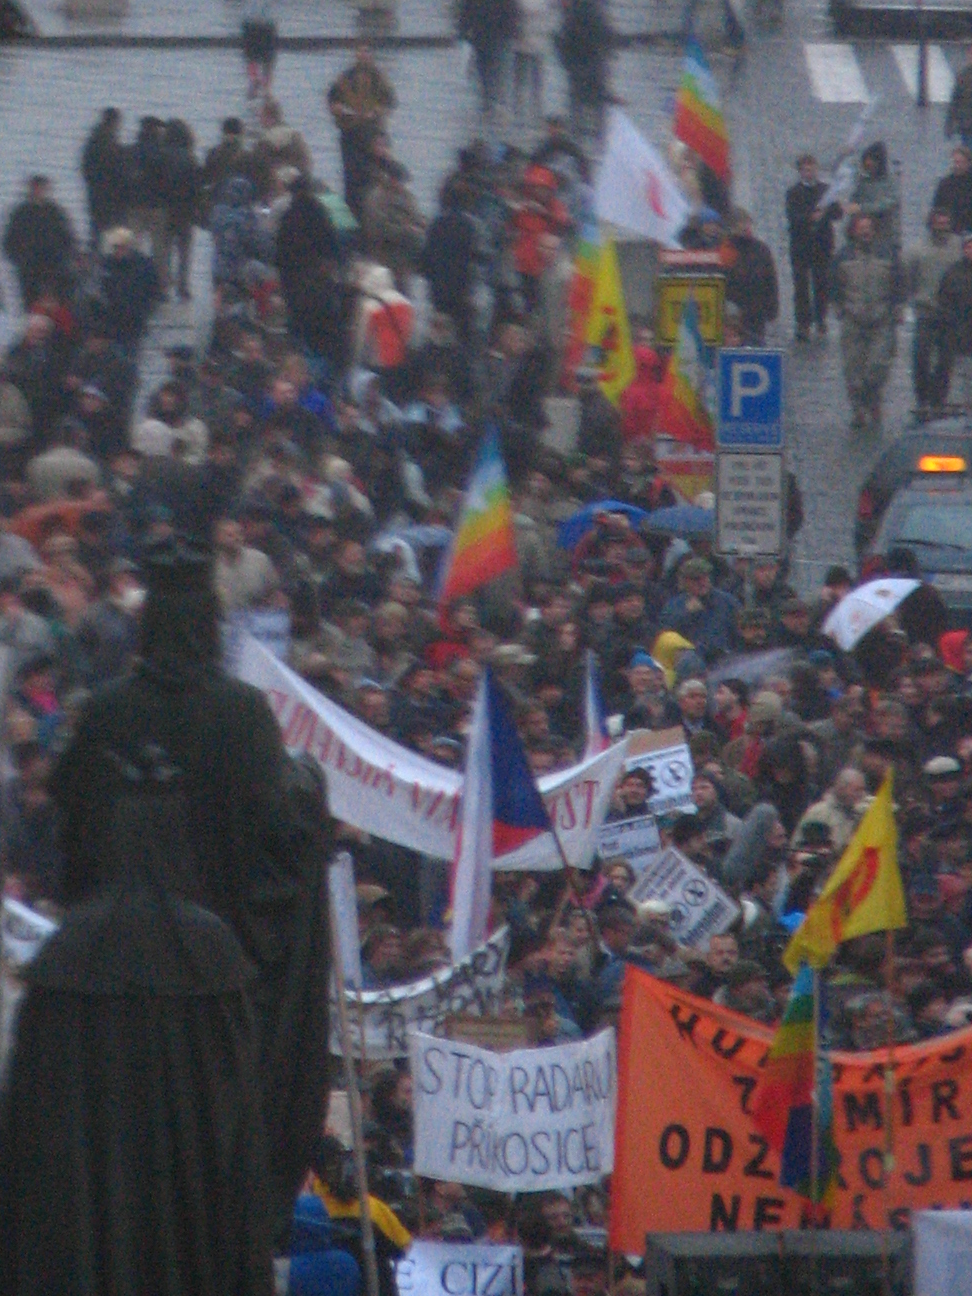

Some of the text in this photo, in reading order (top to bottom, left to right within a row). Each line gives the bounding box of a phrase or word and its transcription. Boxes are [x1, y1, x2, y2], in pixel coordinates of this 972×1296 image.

[731, 362, 770, 417] P
[419, 1047, 613, 1114] STOP RADARU
[842, 1076, 961, 1132] MÍR
